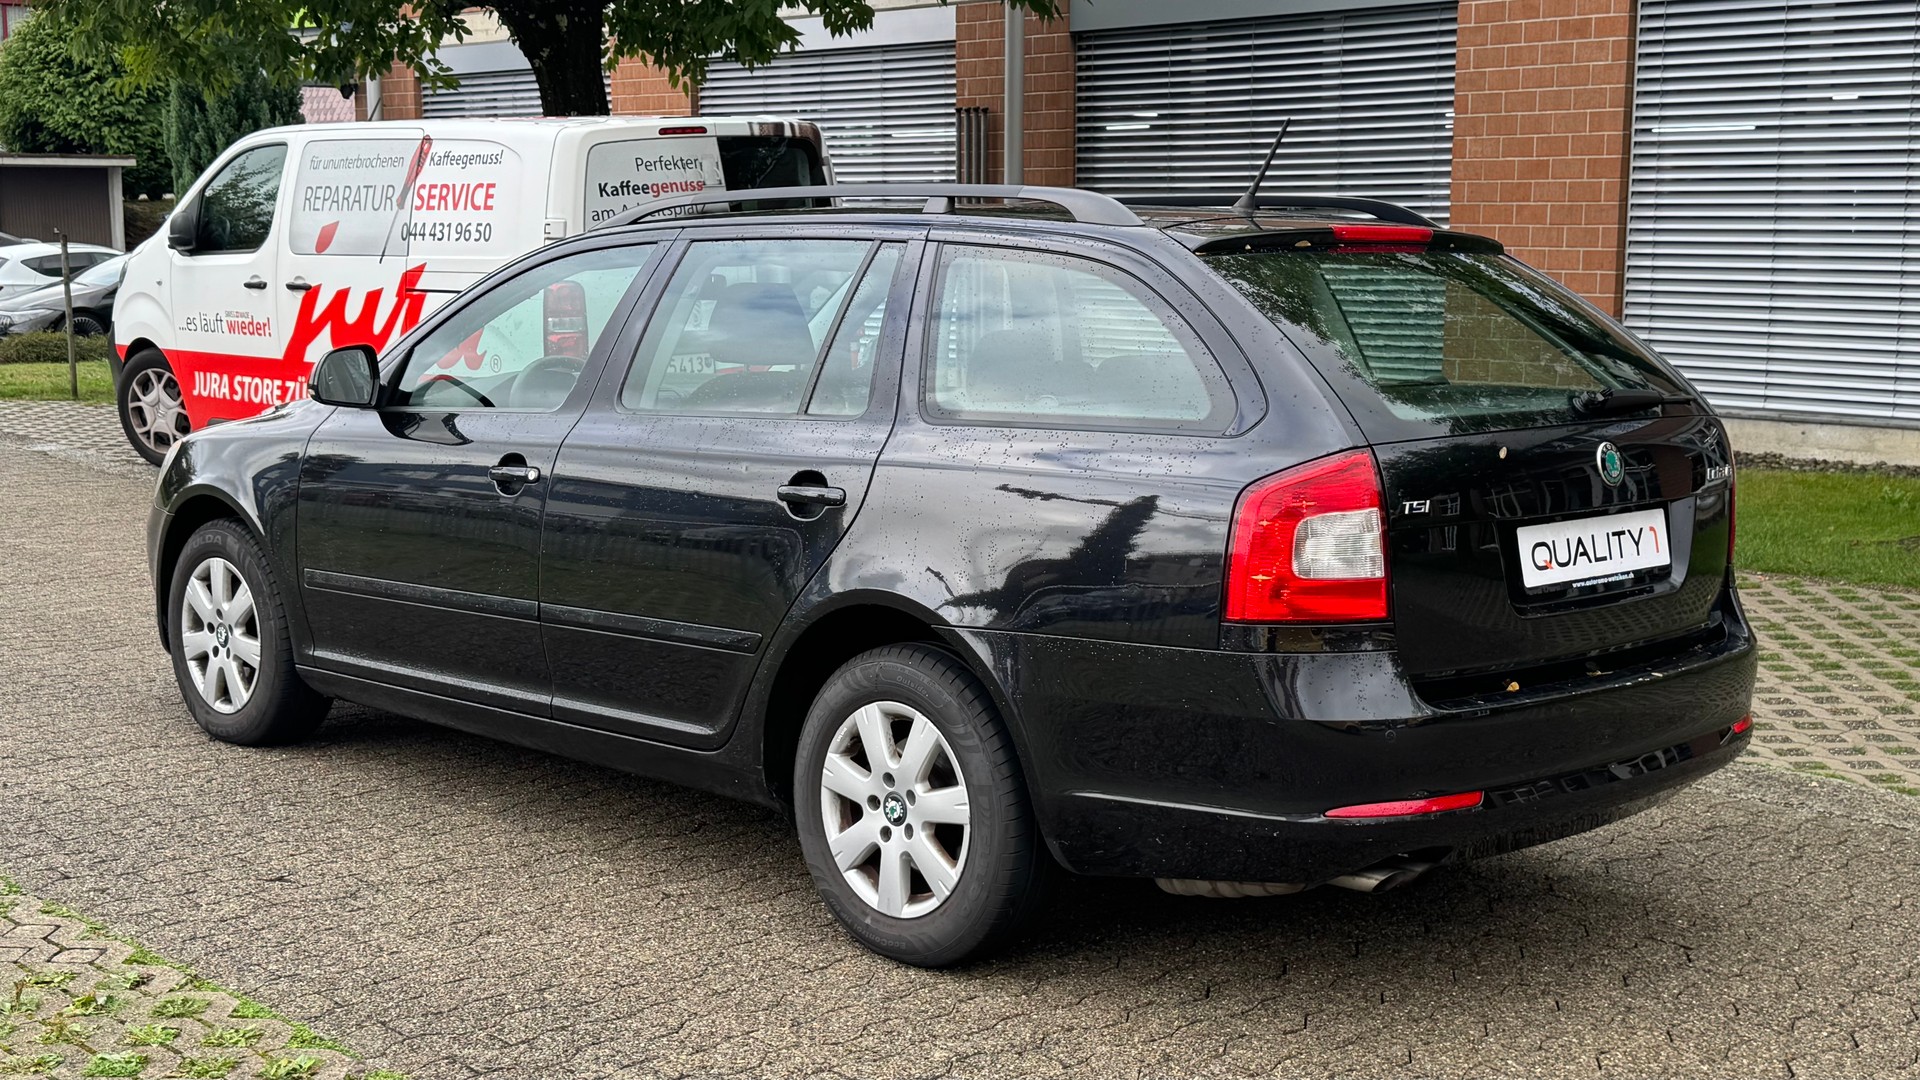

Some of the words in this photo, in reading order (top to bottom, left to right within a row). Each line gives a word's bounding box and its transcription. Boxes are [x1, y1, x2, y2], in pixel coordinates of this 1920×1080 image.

[309, 155, 323, 170] für
[323, 153, 405, 170] ununterbrochenen
[429, 149, 504, 169] Kaffeegenuss!
[635, 156, 699, 172] Perfekter
[302, 184, 396, 212] REPARATUR
[414, 182, 496, 211] SERVICE
[598, 180, 704, 198] Kaffeegenuss
[591, 209, 616, 222] am
[621, 203, 706, 218] Aitsplatz
[401, 222, 426, 241] 044
[429, 222, 451, 242] 431
[455, 222, 471, 242] 96
[474, 222, 492, 242] 50
[199, 312, 225, 334] läuft
[226, 316, 272, 337] wieder!
[192, 370, 230, 399] JURA
[233, 375, 282, 405] STORE
[1403, 500, 1430, 515] TSI
[1531, 527, 1644, 572] QUALITY
[1648, 525, 1661, 554] 1
